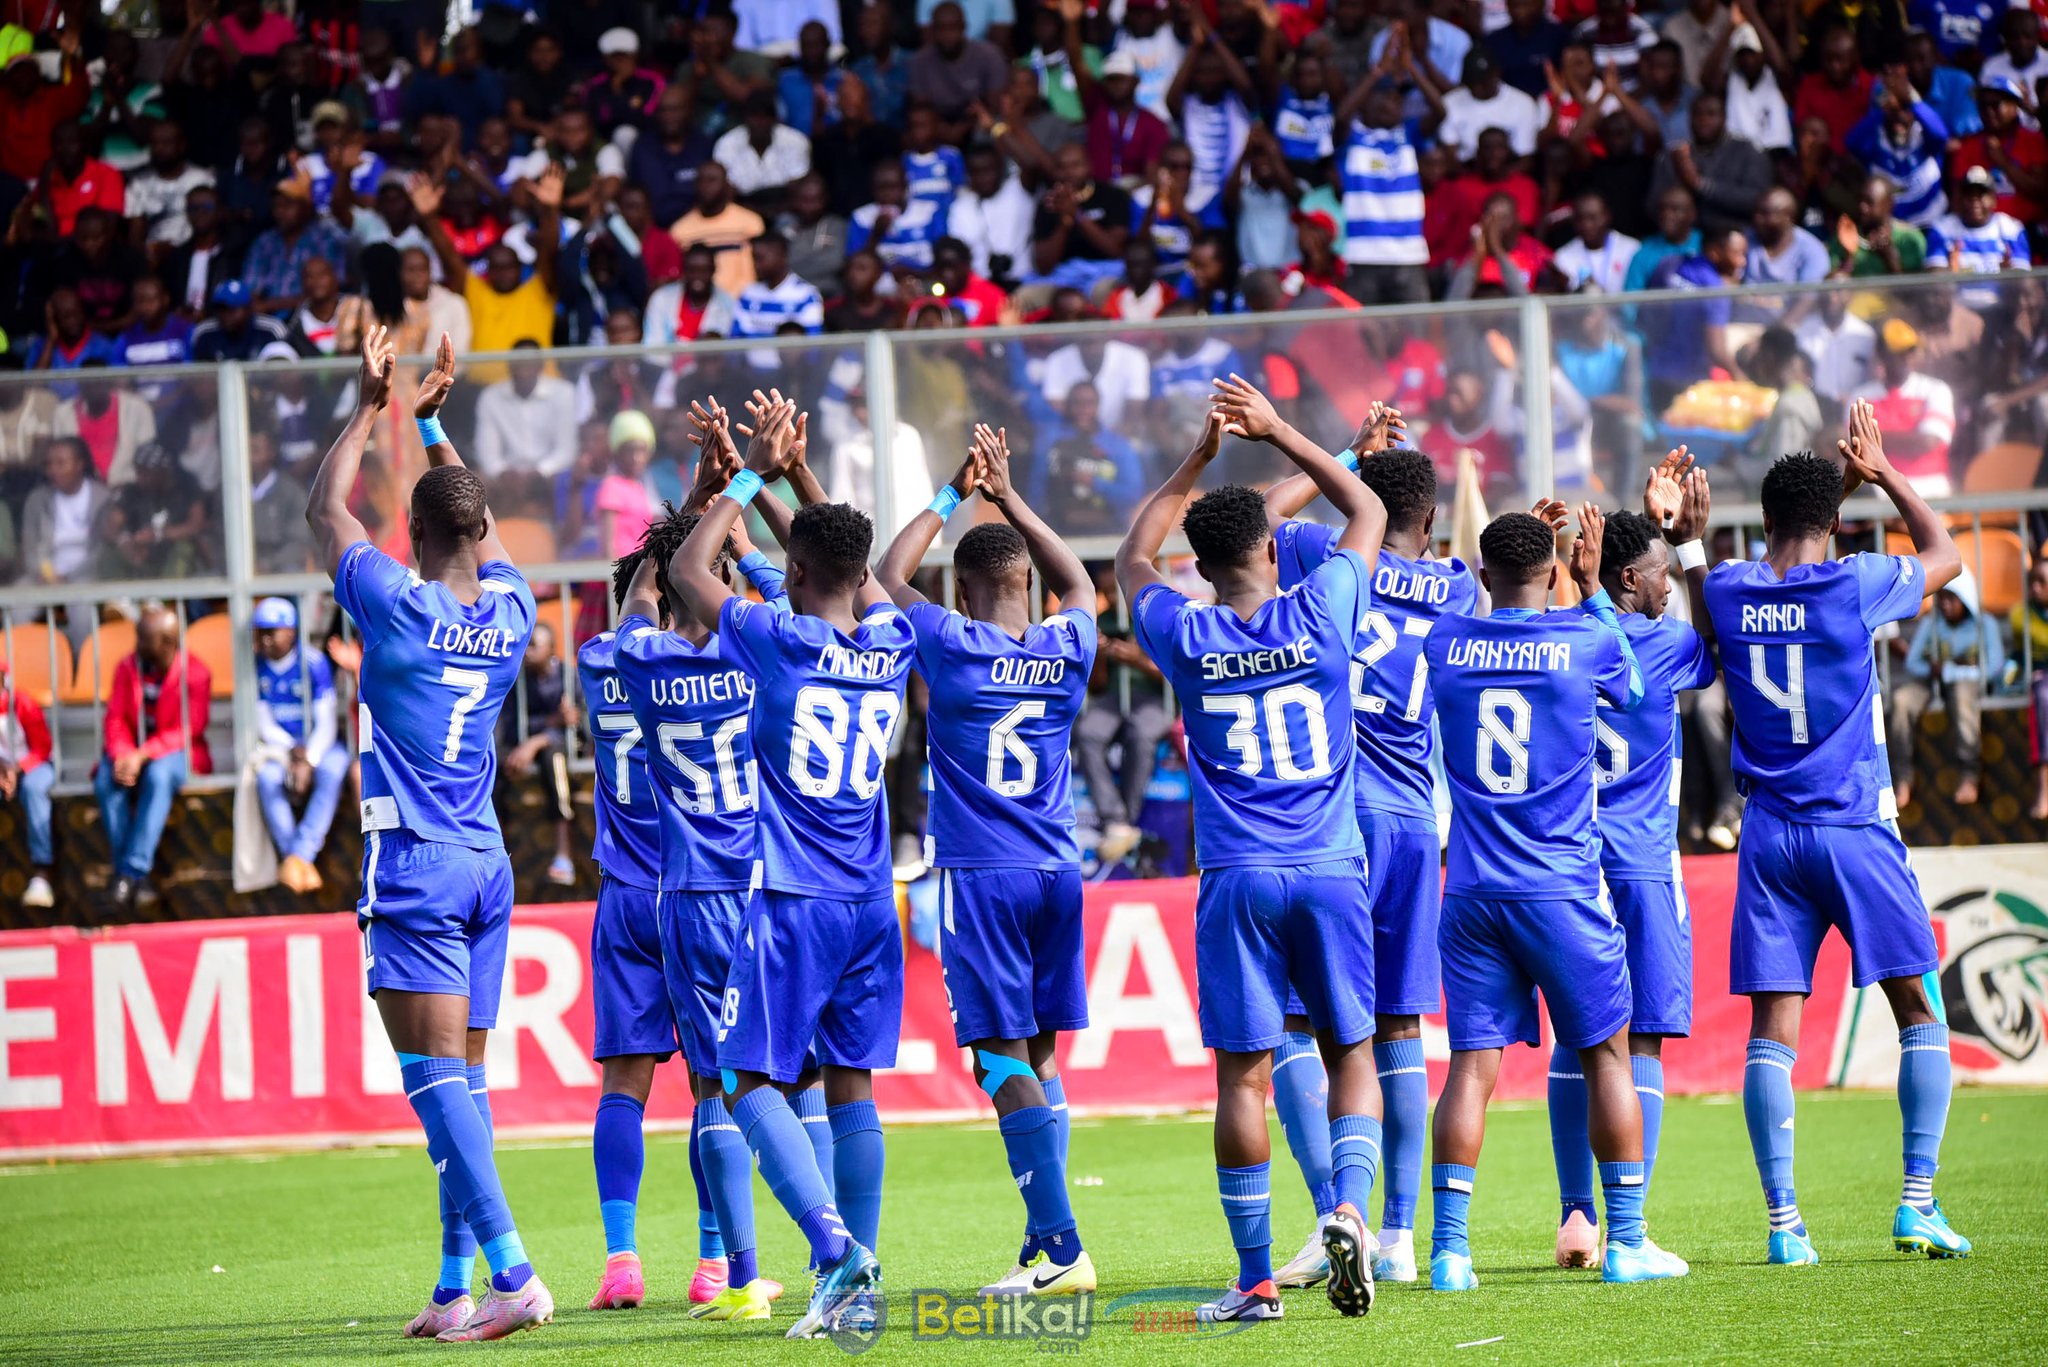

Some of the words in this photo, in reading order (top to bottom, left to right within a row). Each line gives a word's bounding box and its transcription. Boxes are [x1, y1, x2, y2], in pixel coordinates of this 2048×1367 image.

[1375, 566, 1450, 605] OWINO
[1741, 603, 1806, 633] RANDI
[427, 618, 516, 658] LOKALE
[990, 656, 1066, 686] OUNDO
[1201, 634, 1318, 680] SICHENJE
[1349, 610, 1436, 721] 27
[1447, 637, 1571, 671] WANYAMA
[441, 666, 489, 762] 7
[1201, 682, 1333, 781] 30
[1476, 688, 1532, 794] 8
[1749, 644, 1809, 744] 4
[596, 713, 644, 805] 7
[788, 685, 901, 800] 88
[986, 700, 1047, 798] 6
[0, 924, 601, 1111] EMIR
